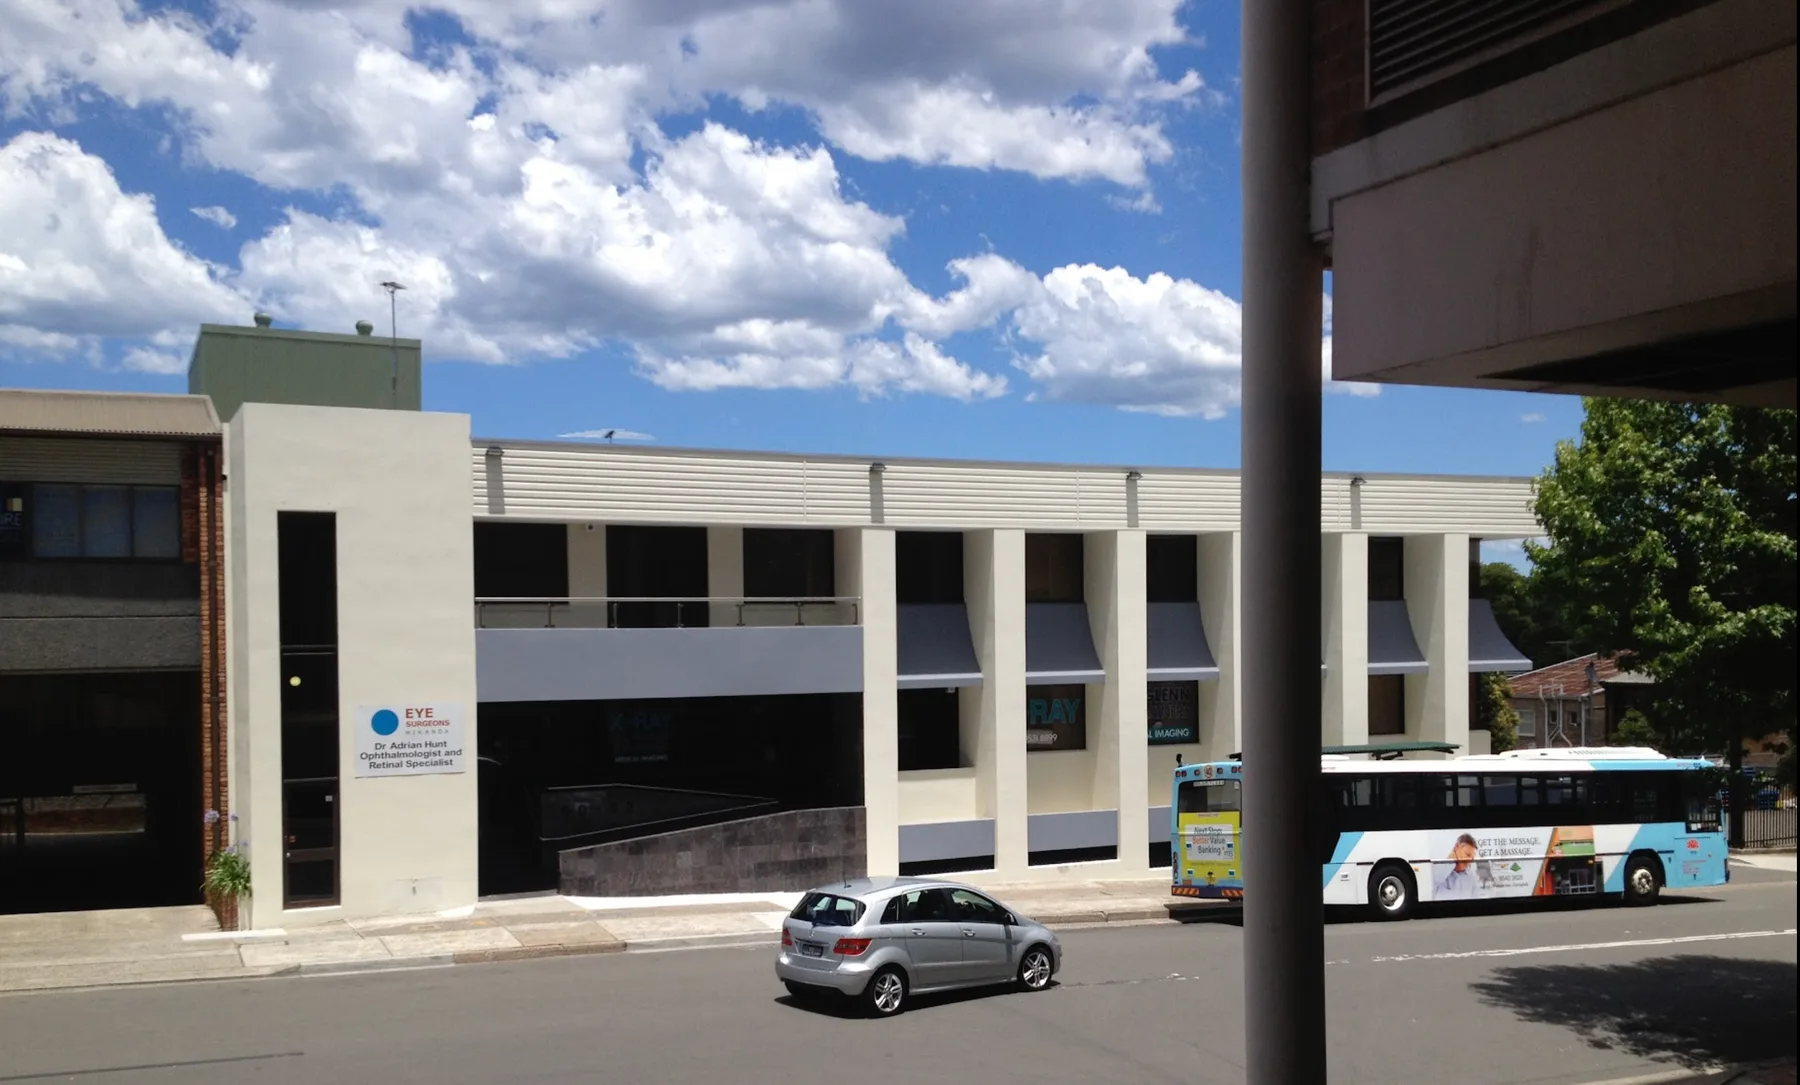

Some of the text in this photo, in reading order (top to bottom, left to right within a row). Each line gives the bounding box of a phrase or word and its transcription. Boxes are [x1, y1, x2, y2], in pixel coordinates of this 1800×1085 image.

[405, 708, 433, 719] EYE
[1154, 728, 1190, 738] IMAGING
[374, 740, 447, 751] Dr Adrian Hunt
[360, 749, 462, 761] Ophthalmologist and
[369, 758, 453, 769] Retinal Specialist
[1209, 836, 1226, 844] Value
[1478, 839, 1492, 847] GET
[1493, 838, 1508, 846] THE
[1479, 849, 1492, 857] GET
